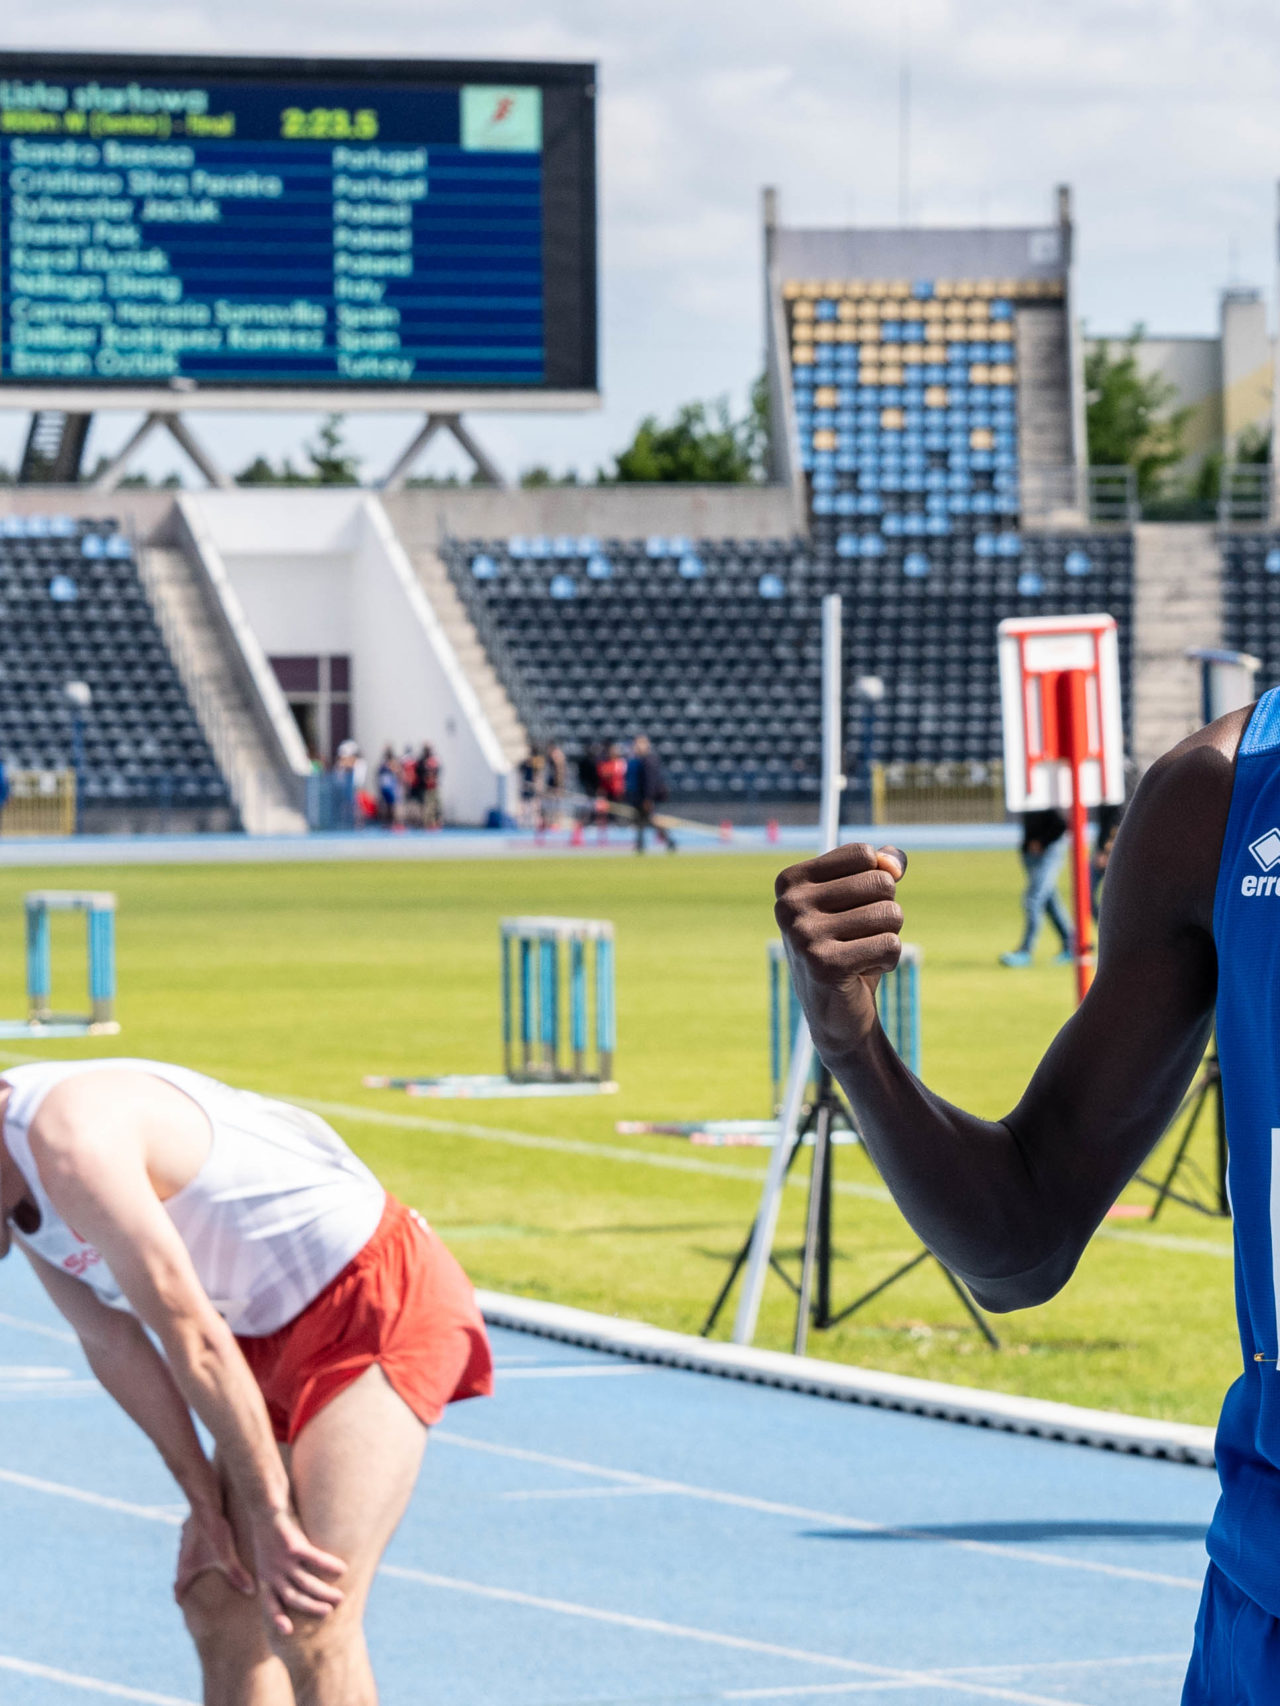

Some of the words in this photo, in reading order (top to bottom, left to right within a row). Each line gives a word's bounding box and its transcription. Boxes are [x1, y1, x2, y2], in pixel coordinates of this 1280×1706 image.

[333, 147, 427, 174] Portugal
[333, 175, 427, 201] Portugal
[334, 201, 411, 225] Poland
[334, 226, 411, 250] Poland
[334, 252, 411, 276] Poland
[334, 276, 385, 302] Italy
[337, 304, 399, 329] Spain
[337, 329, 399, 352] Spain
[338, 353, 414, 380] Turkey
